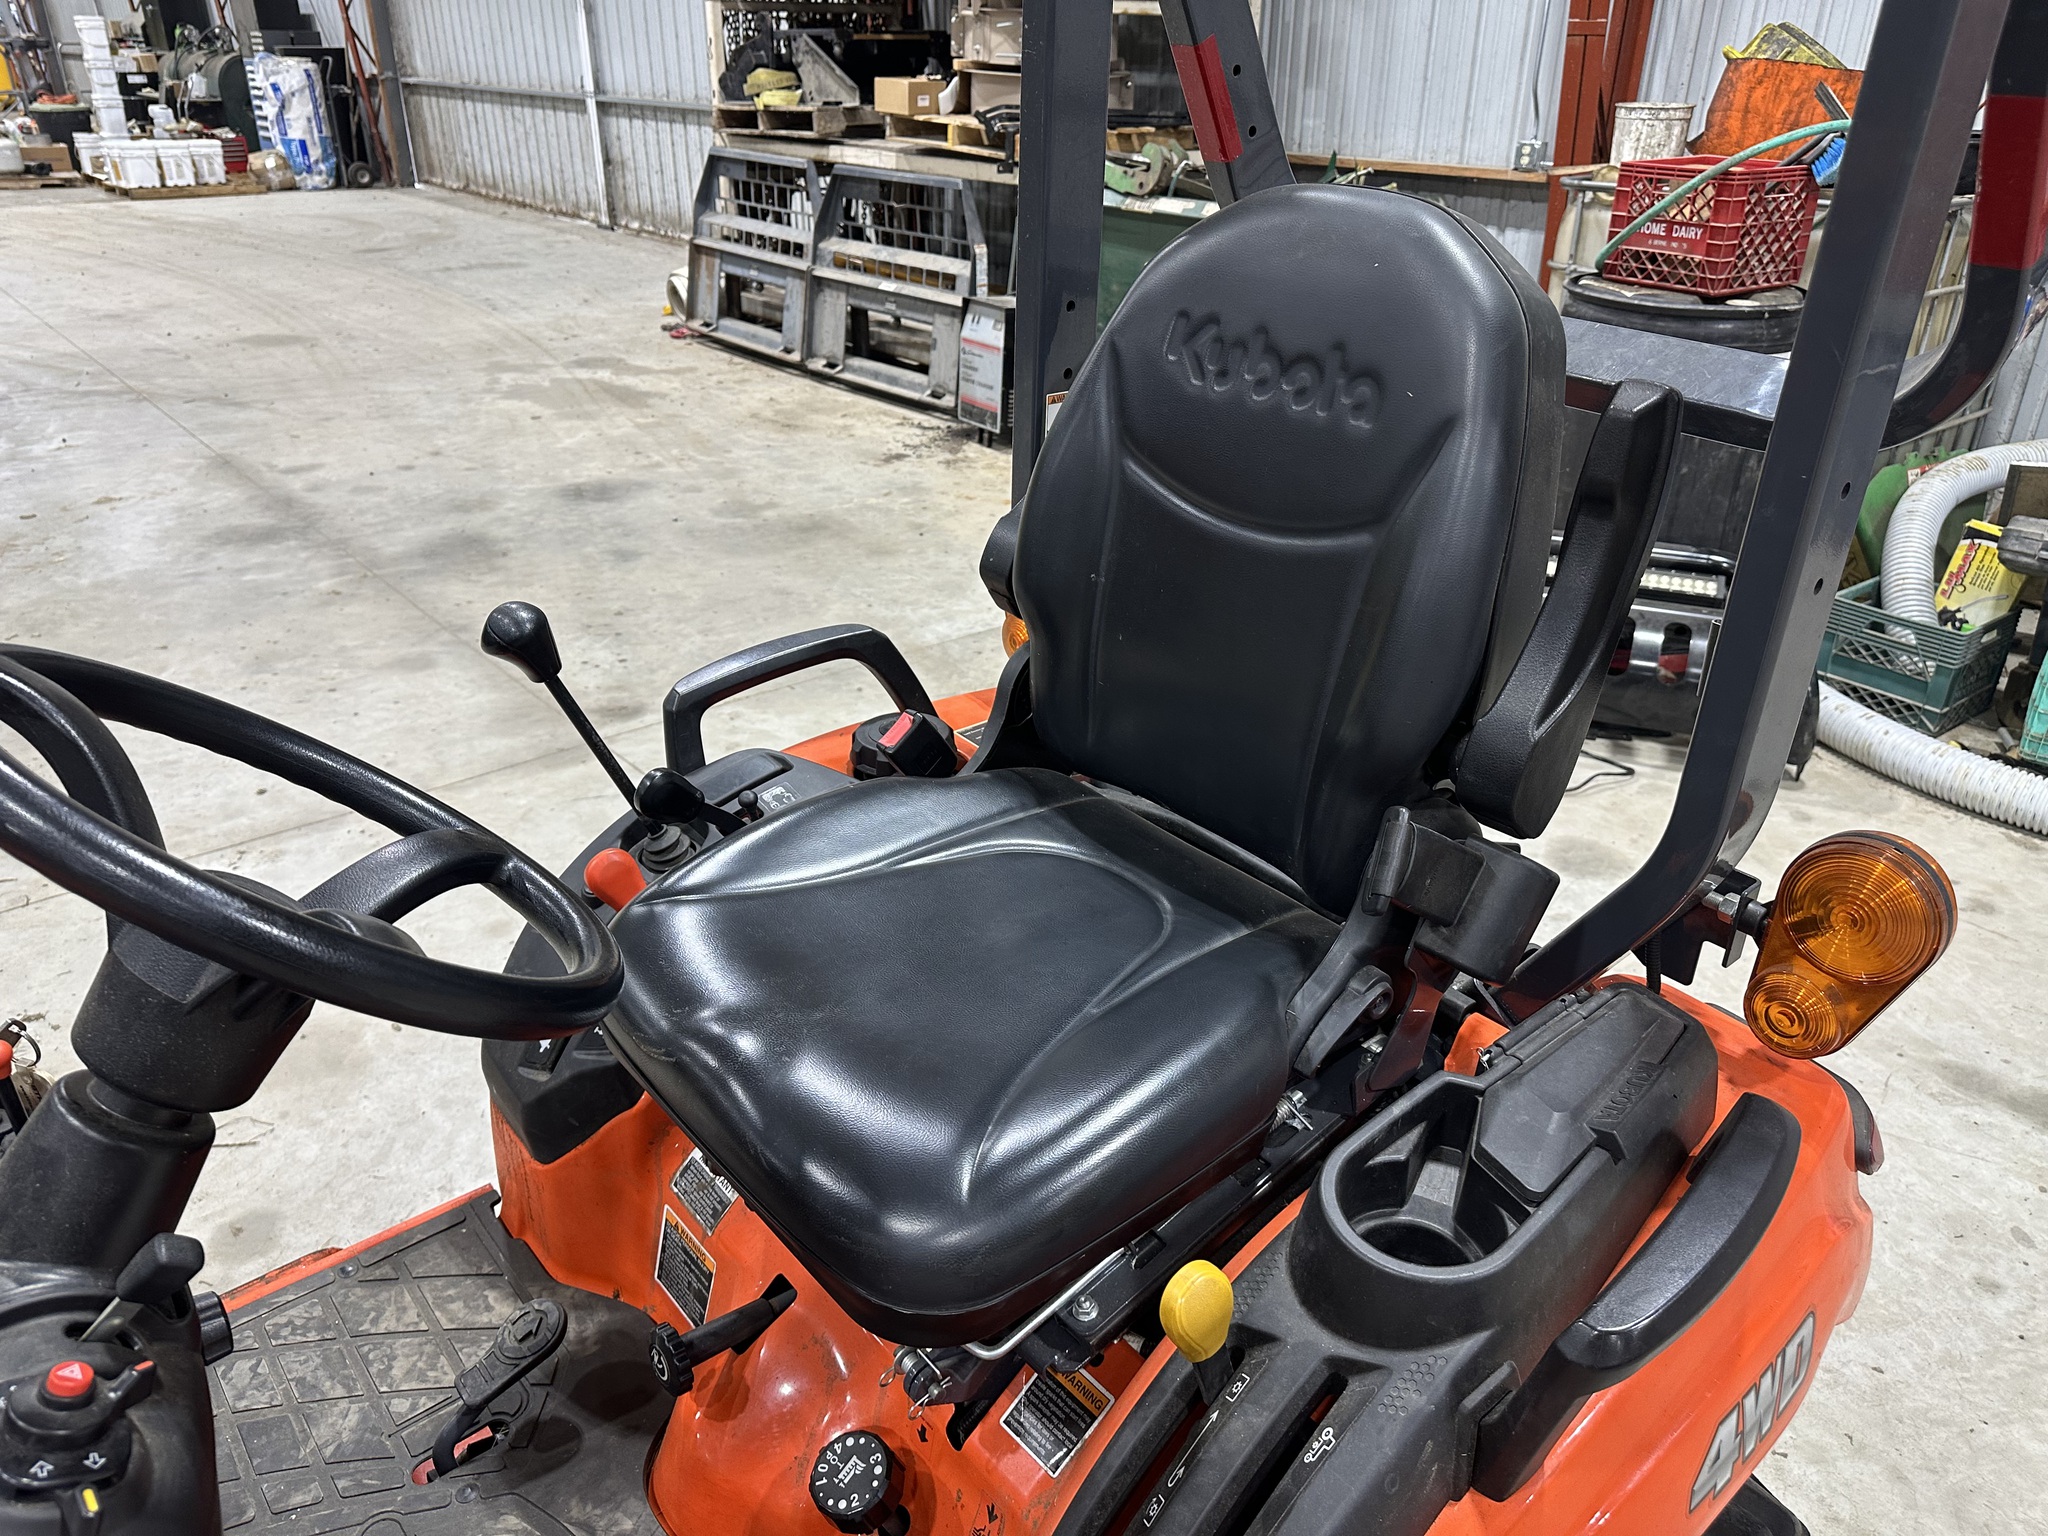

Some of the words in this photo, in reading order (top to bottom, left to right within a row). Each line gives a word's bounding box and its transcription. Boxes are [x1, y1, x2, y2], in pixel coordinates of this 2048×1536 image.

[1672, 225, 1703, 240] DAIRY
[1162, 309, 1382, 430] Kubota
[1940, 540, 1981, 600] LUMAX
[1592, 1060, 1659, 1121] KUBOTA
[680, 1226, 707, 1262] WARNING
[1061, 1370, 1104, 1411] WARNING
[1688, 1311, 1816, 1514] 4WD
[834, 1442, 842, 1454] 4
[818, 1463, 829, 1472] 0
[826, 1451, 844, 1470] TOP
[870, 1453, 882, 1464] 3
[815, 1476, 828, 1486] 1
[850, 1493, 860, 1508] 2
